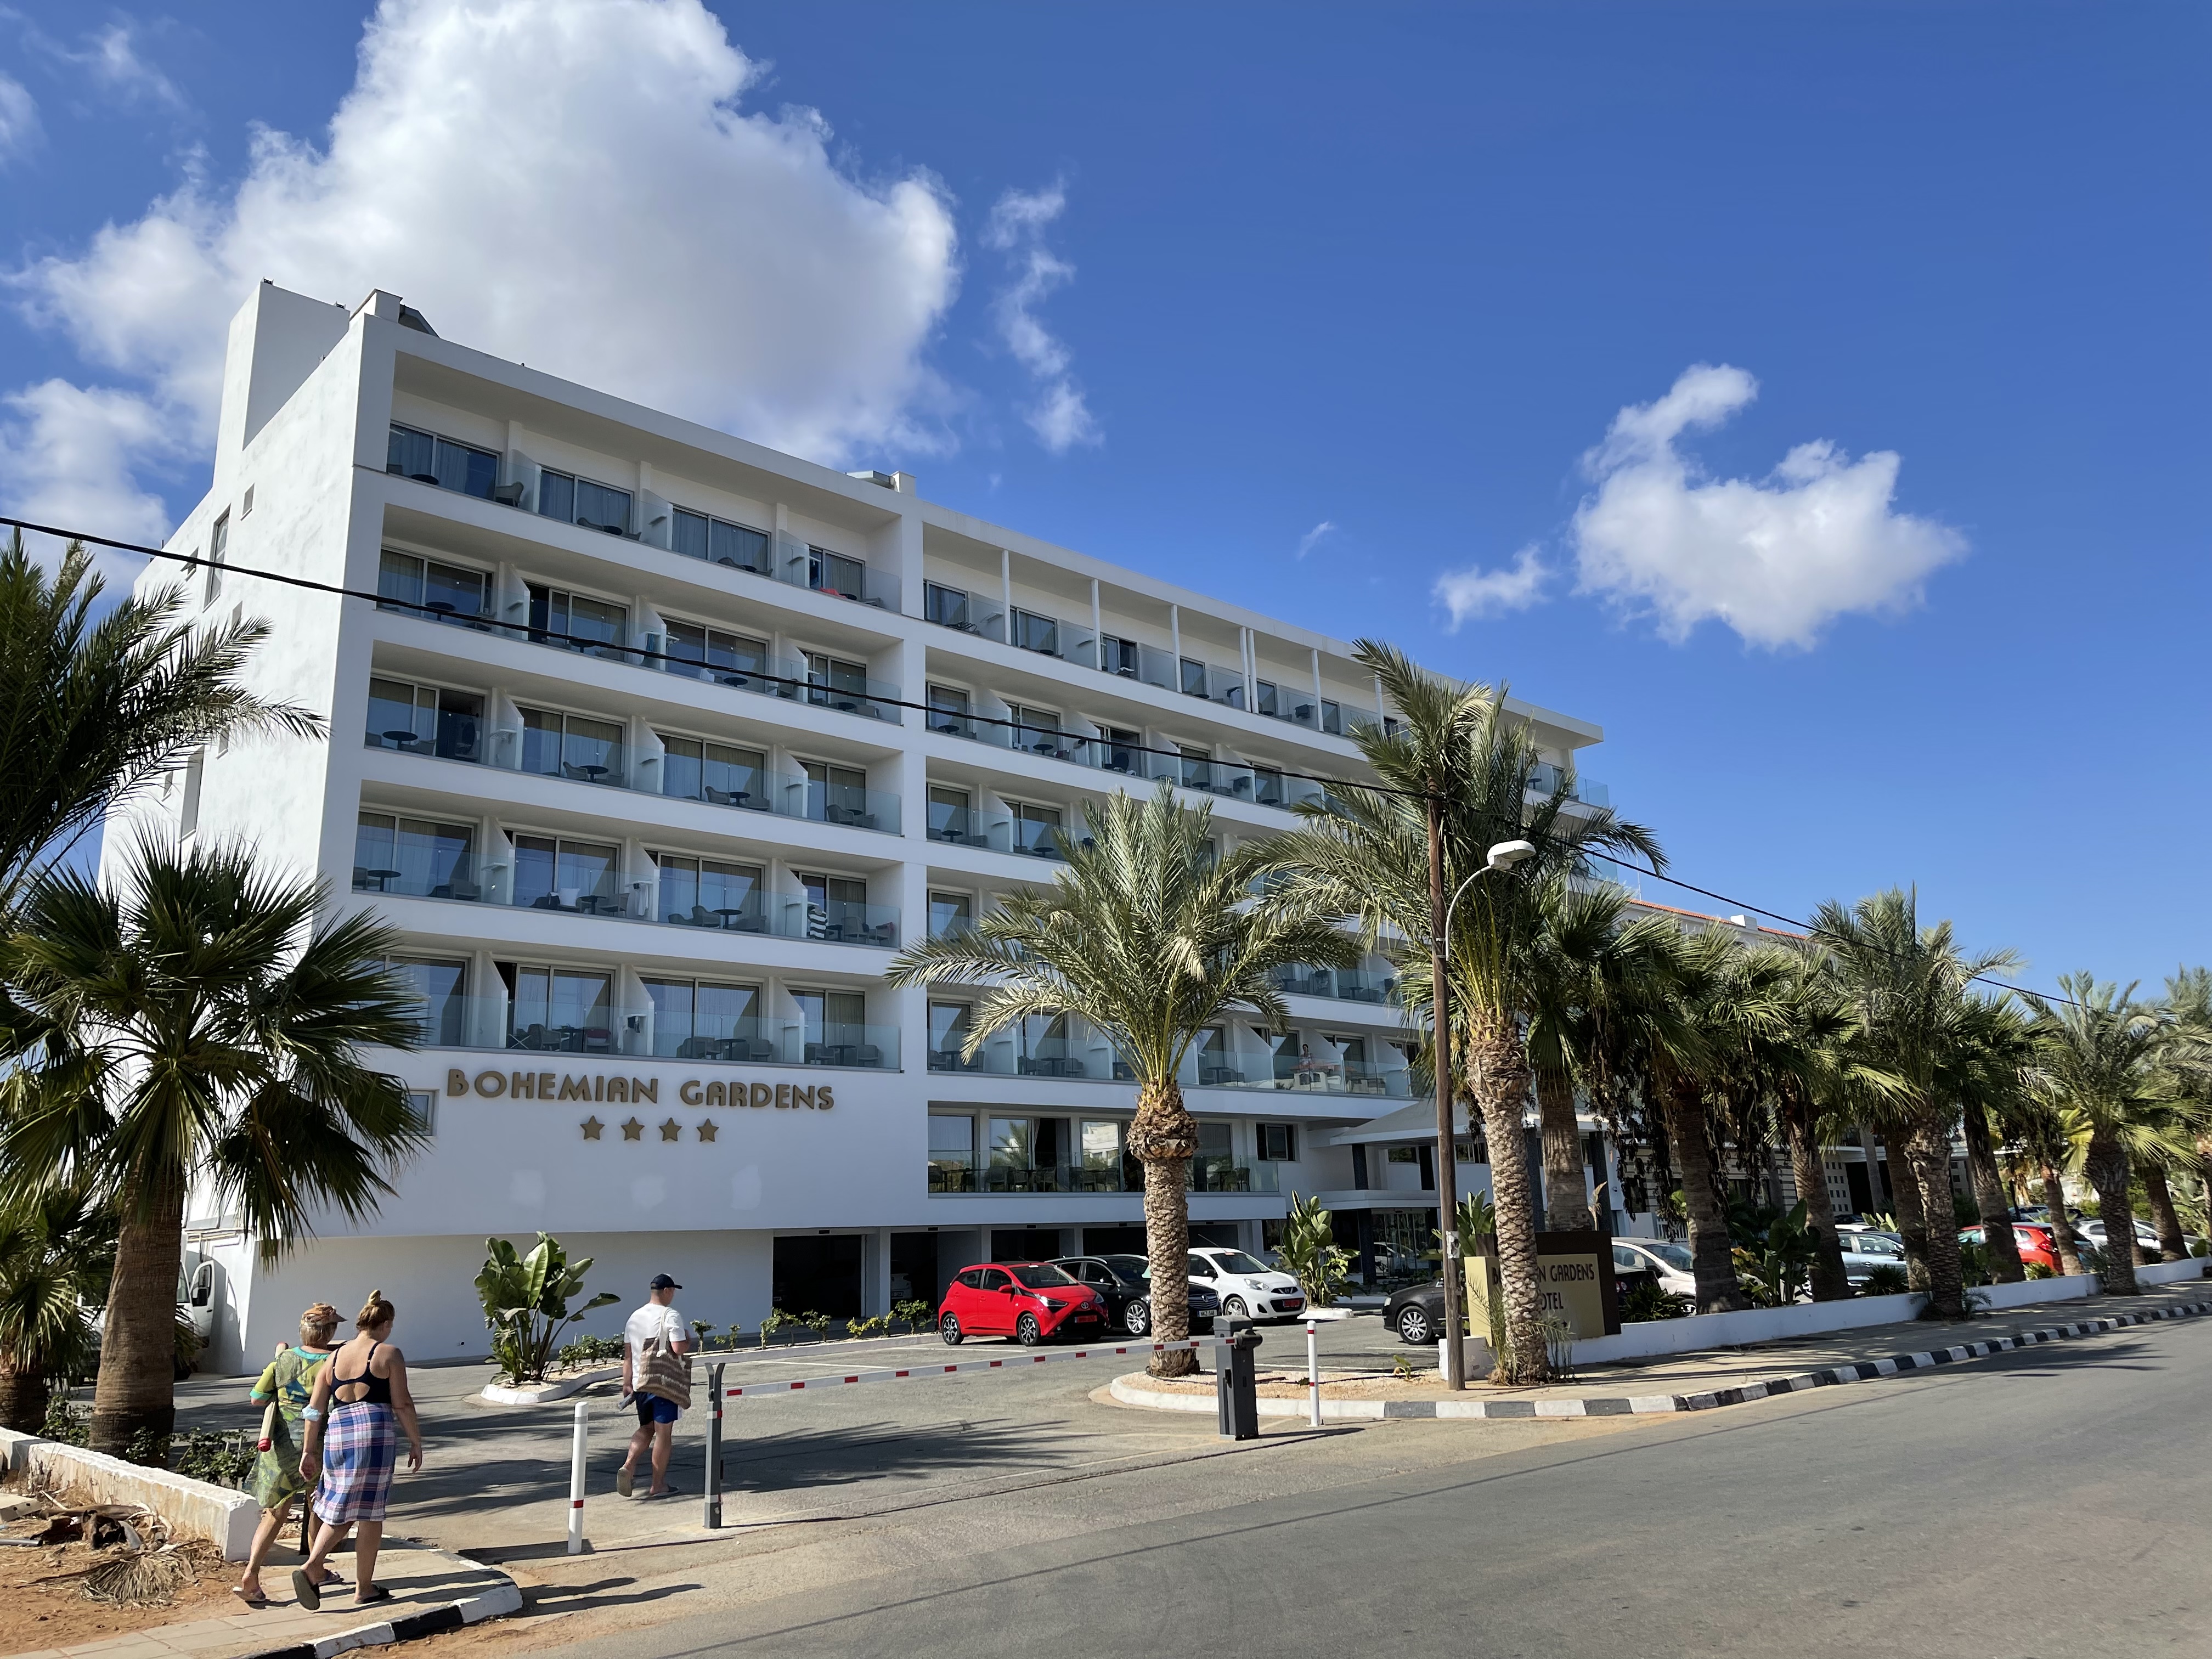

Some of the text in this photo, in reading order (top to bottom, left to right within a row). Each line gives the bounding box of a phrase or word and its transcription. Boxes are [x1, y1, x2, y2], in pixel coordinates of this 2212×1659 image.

[447, 1069, 834, 1110] BOHEMIAN GARDENS
[1550, 1263, 1595, 1282] GARDENS
[1542, 1292, 1564, 1310] OTEL
